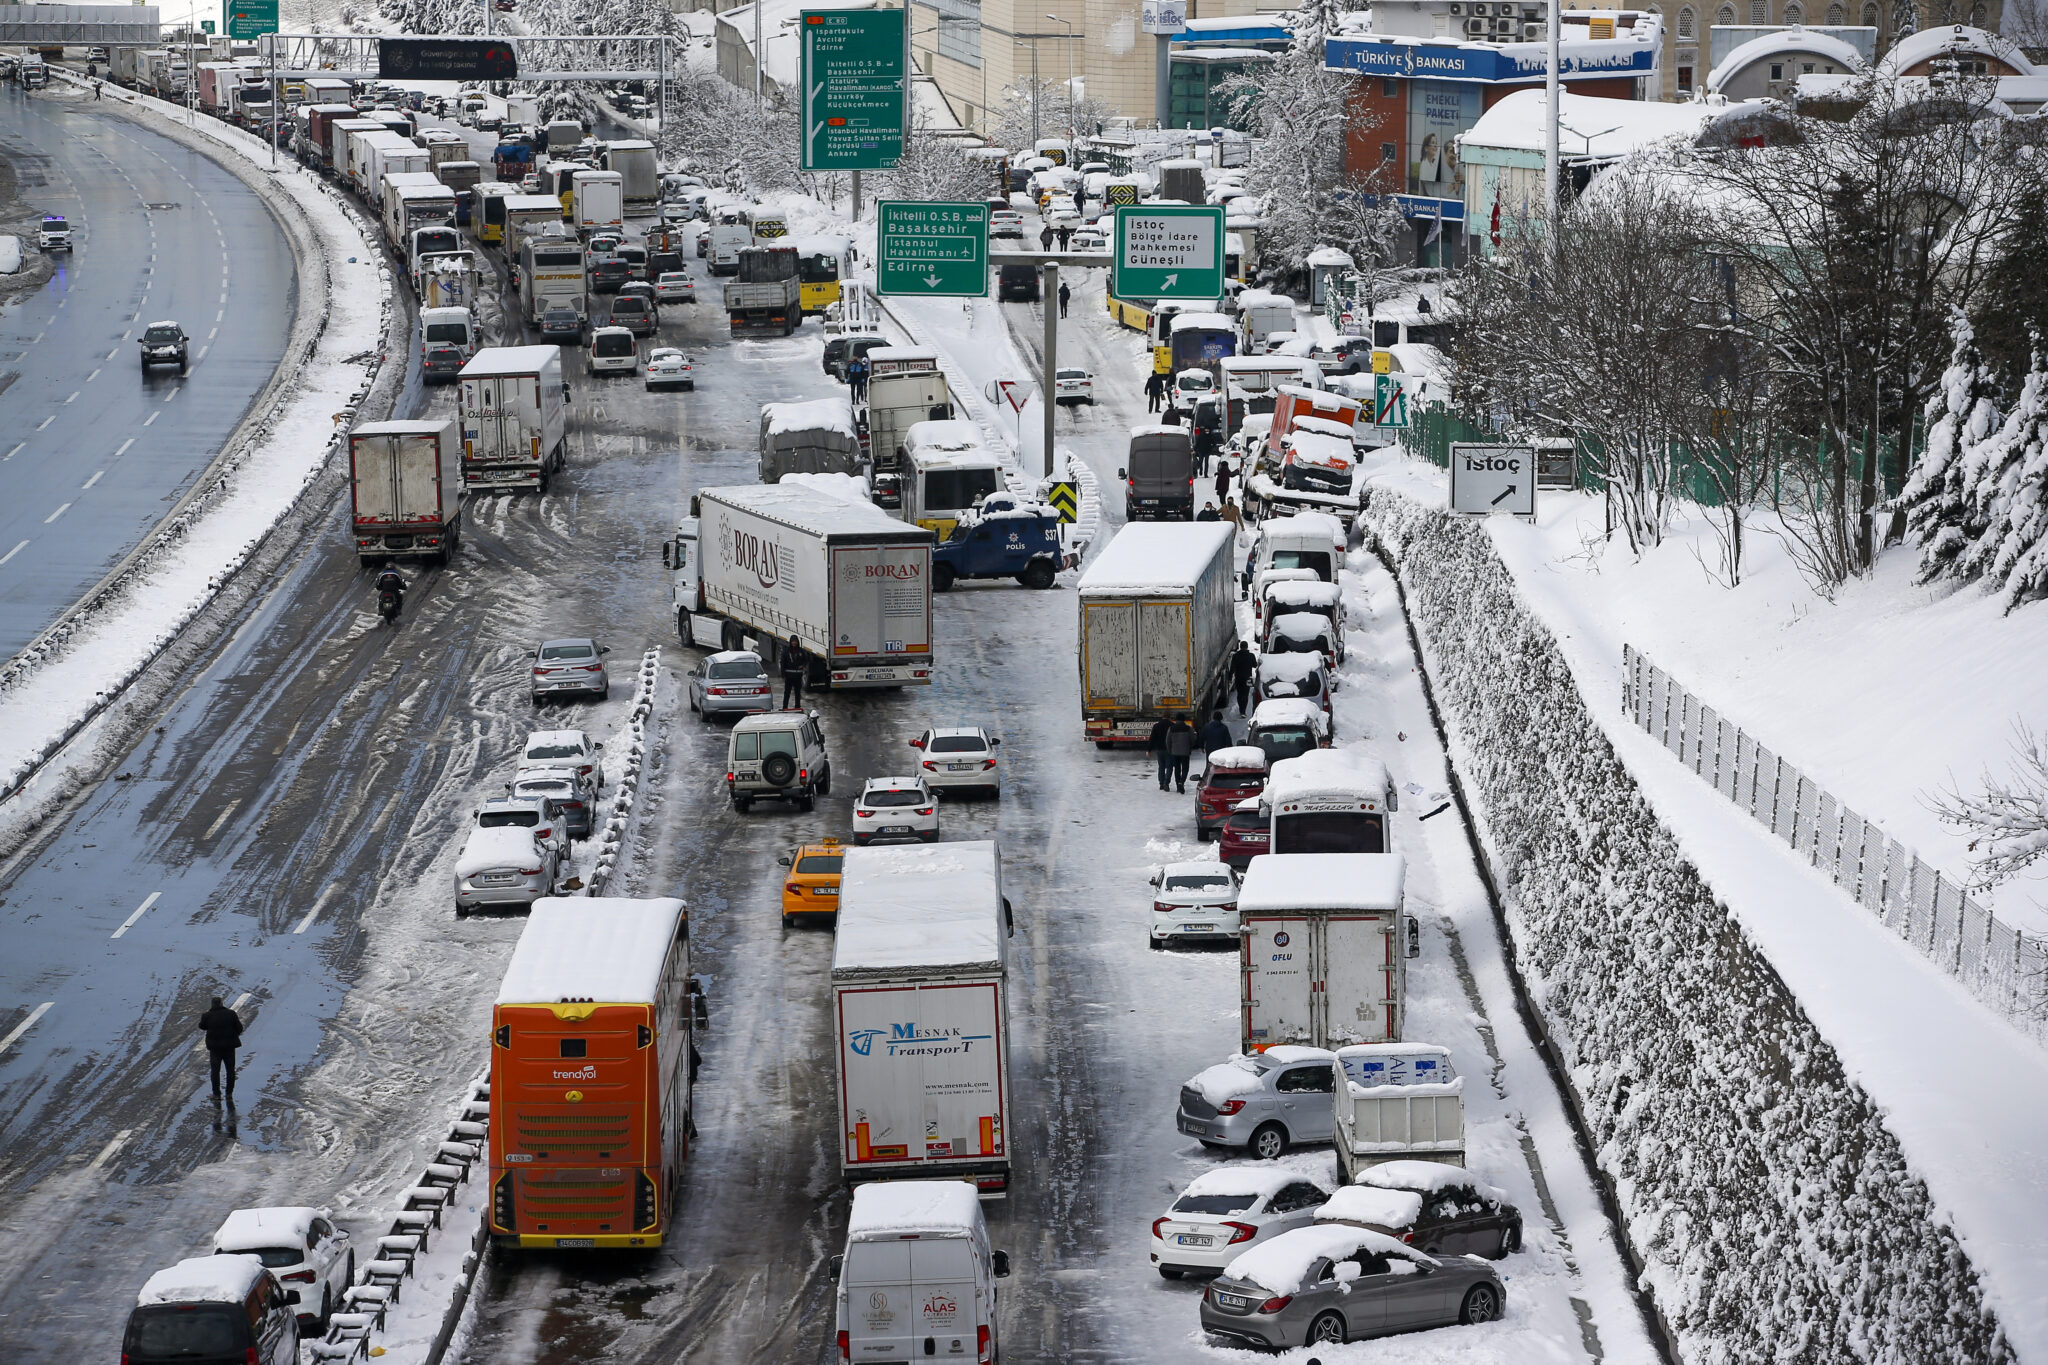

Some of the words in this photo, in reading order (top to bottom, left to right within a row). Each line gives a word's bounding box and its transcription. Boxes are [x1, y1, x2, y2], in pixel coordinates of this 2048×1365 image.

[1355, 49, 1403, 66] TÜRKİYE
[1416, 57, 1465, 71] BANKASI
[827, 93, 865, 101] Bakırköy
[888, 209, 926, 221] İkitelli
[929, 212, 963, 222] O.S.B.
[888, 223, 967, 234] Başakşehir
[1131, 218, 1165, 231] İstoç
[890, 237, 938, 247] İstanbul
[1131, 232, 1163, 242] Bölge
[1168, 231, 1199, 241] İdare
[889, 248, 957, 257] Havalimanı
[1131, 243, 1195, 252] Mahkemesi
[1130, 255, 1184, 266] Güneşli
[887, 261, 935, 272] Edirne
[1045, 529, 1057, 541] S37
[1006, 542, 1026, 550] POLİS
[733, 529, 779, 588] BORAN
[864, 563, 921, 580] BORAN
[885, 640, 903, 651] TIR
[1277, 935, 1287, 944] 61
[1272, 954, 1292, 962] OFLU
[890, 1022, 961, 1039] MESNAK
[886, 1041, 973, 1056] TransporT
[553, 1069, 597, 1080] trendyol
[923, 1296, 957, 1313] ALAS
